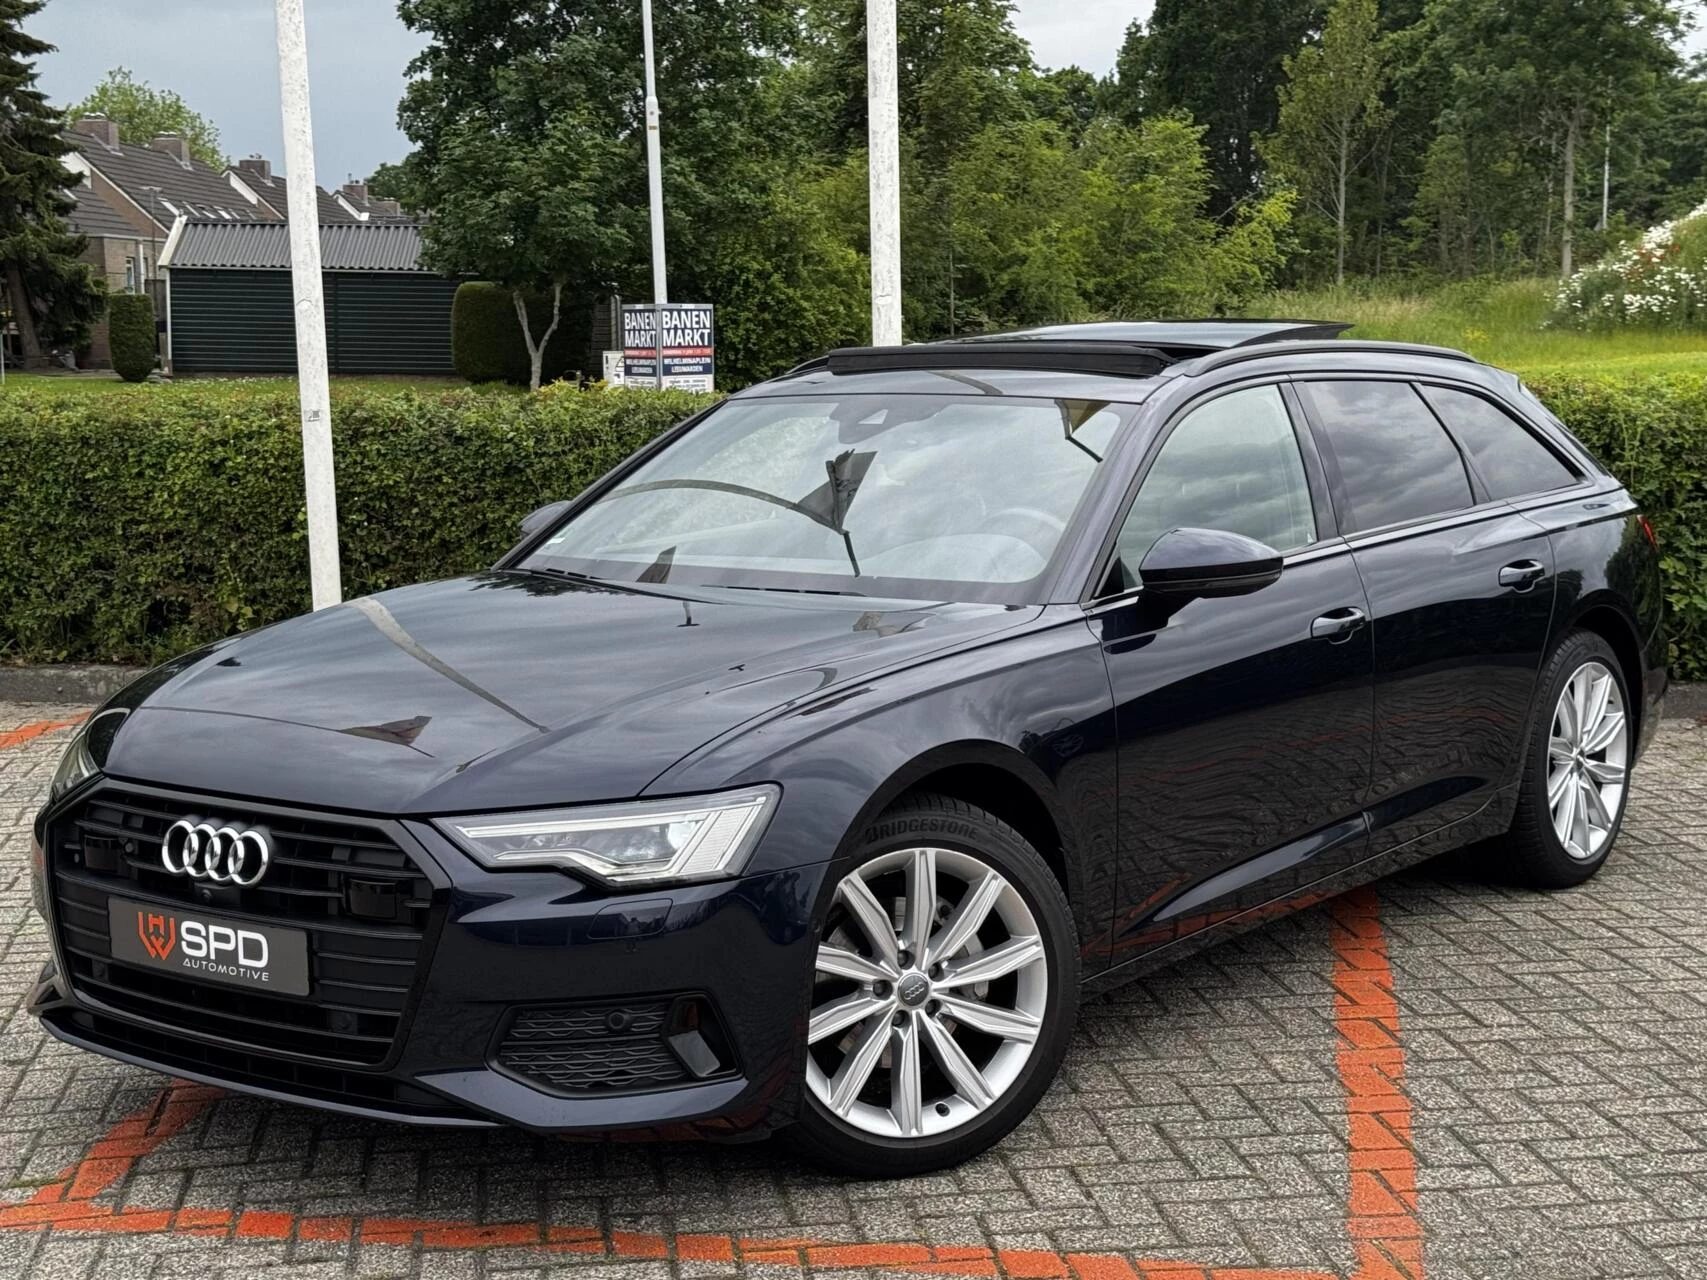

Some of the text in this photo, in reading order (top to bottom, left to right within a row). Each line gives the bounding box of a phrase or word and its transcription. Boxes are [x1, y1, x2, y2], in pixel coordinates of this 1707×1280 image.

[624, 312, 656, 330] BANEN
[662, 310, 711, 329] BANEN
[624, 330, 656, 348] MARKT
[662, 329, 711, 347] MARKT
[864, 817, 980, 845] BRIDGESTONE
[180, 920, 269, 969] SPD
[182, 957, 270, 982] AUTOMOTIVE
